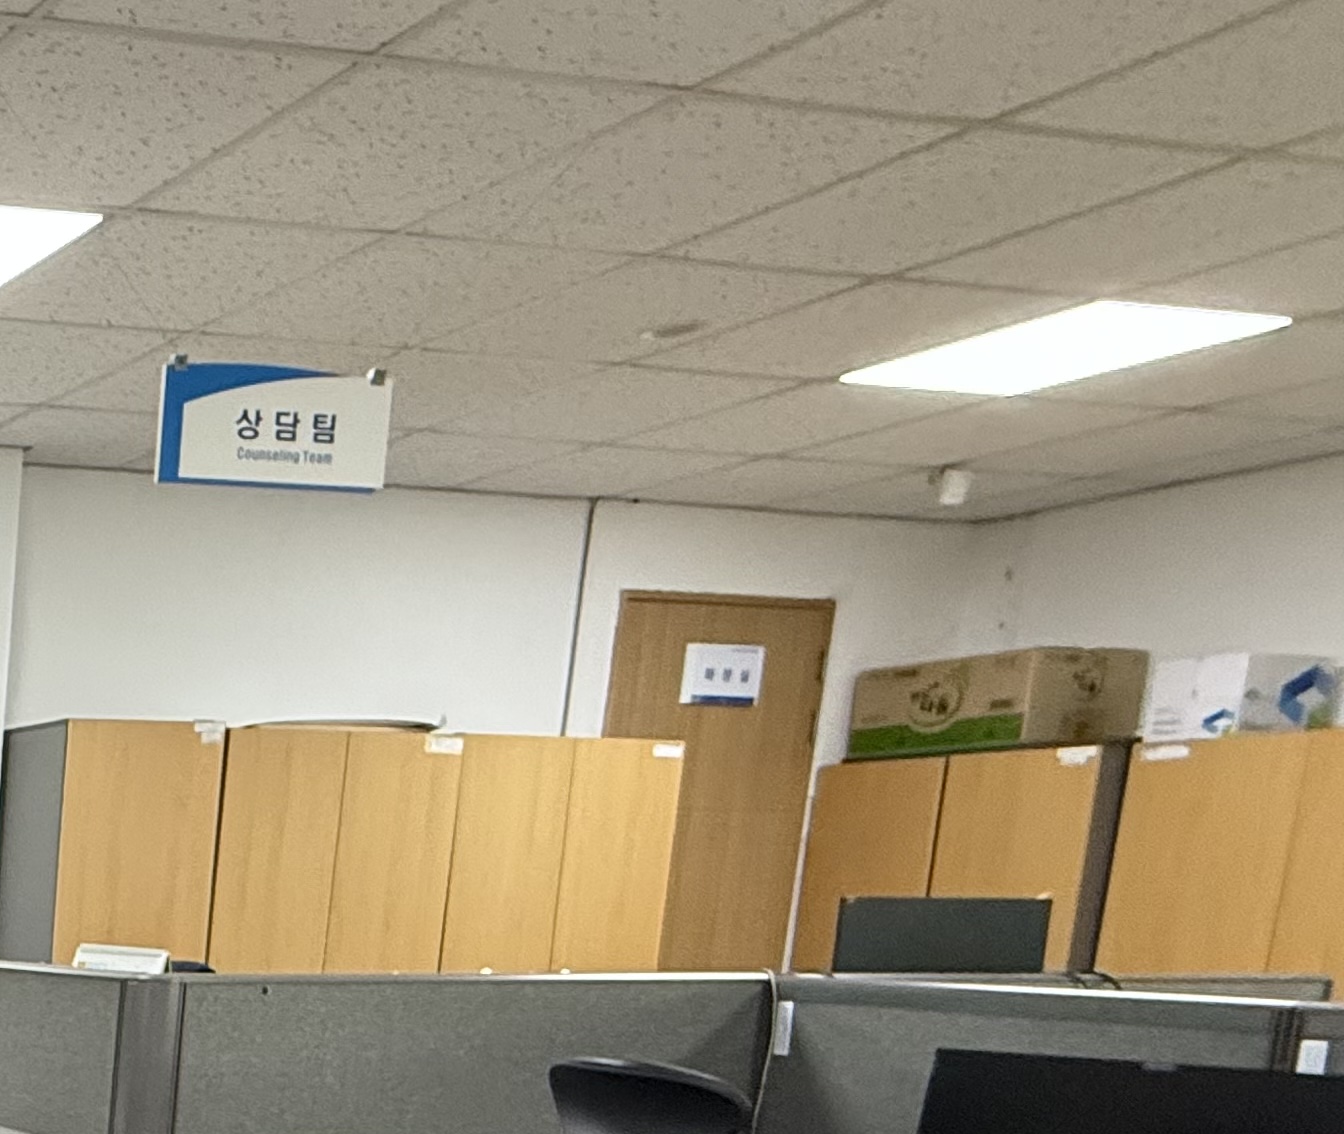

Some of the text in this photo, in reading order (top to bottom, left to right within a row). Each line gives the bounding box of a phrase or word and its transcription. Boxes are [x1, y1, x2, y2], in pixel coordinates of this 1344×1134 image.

[235, 408, 336, 444] 상담팀
[236, 446, 333, 464] Counseling Team
